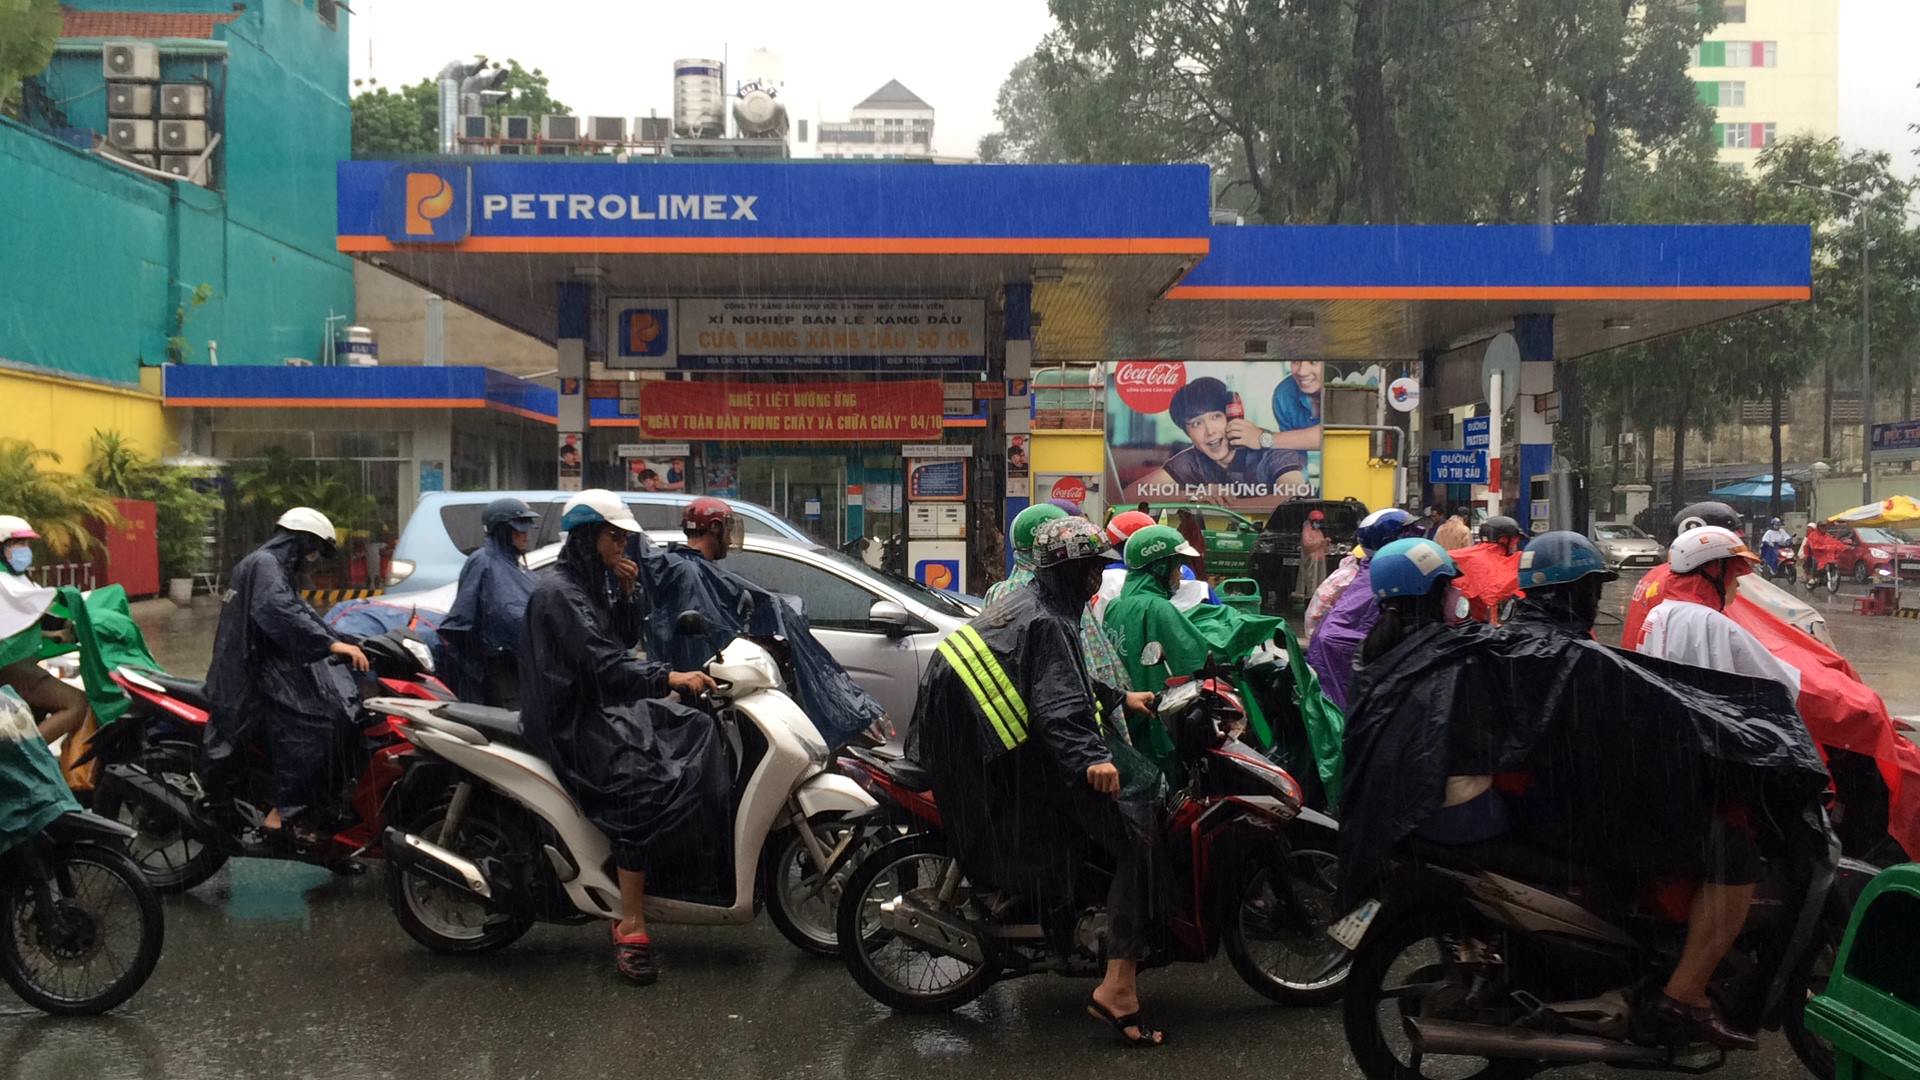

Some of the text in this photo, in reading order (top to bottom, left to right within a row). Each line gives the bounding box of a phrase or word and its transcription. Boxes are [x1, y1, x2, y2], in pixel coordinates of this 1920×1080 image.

[483, 193, 759, 221] PETROLIMEX
[708, 313, 724, 325] XÍ
[732, 313, 794, 326] NGHIỆP
[1116, 362, 1183, 385] Coca-Cola
[765, 391, 790, 410] LIỆT
[744, 413, 781, 431] PHÒNG
[784, 413, 815, 431] CHÁY
[818, 412, 834, 431] VÀ
[910, 414, 942, 430] 04/10
[1441, 453, 1476, 463] ĐƯỜNG
[1437, 465, 1481, 480] VÕ THỊ SÁU
[1218, 480, 1268, 497] HỨNG
[1139, 540, 1168, 557] Grab
